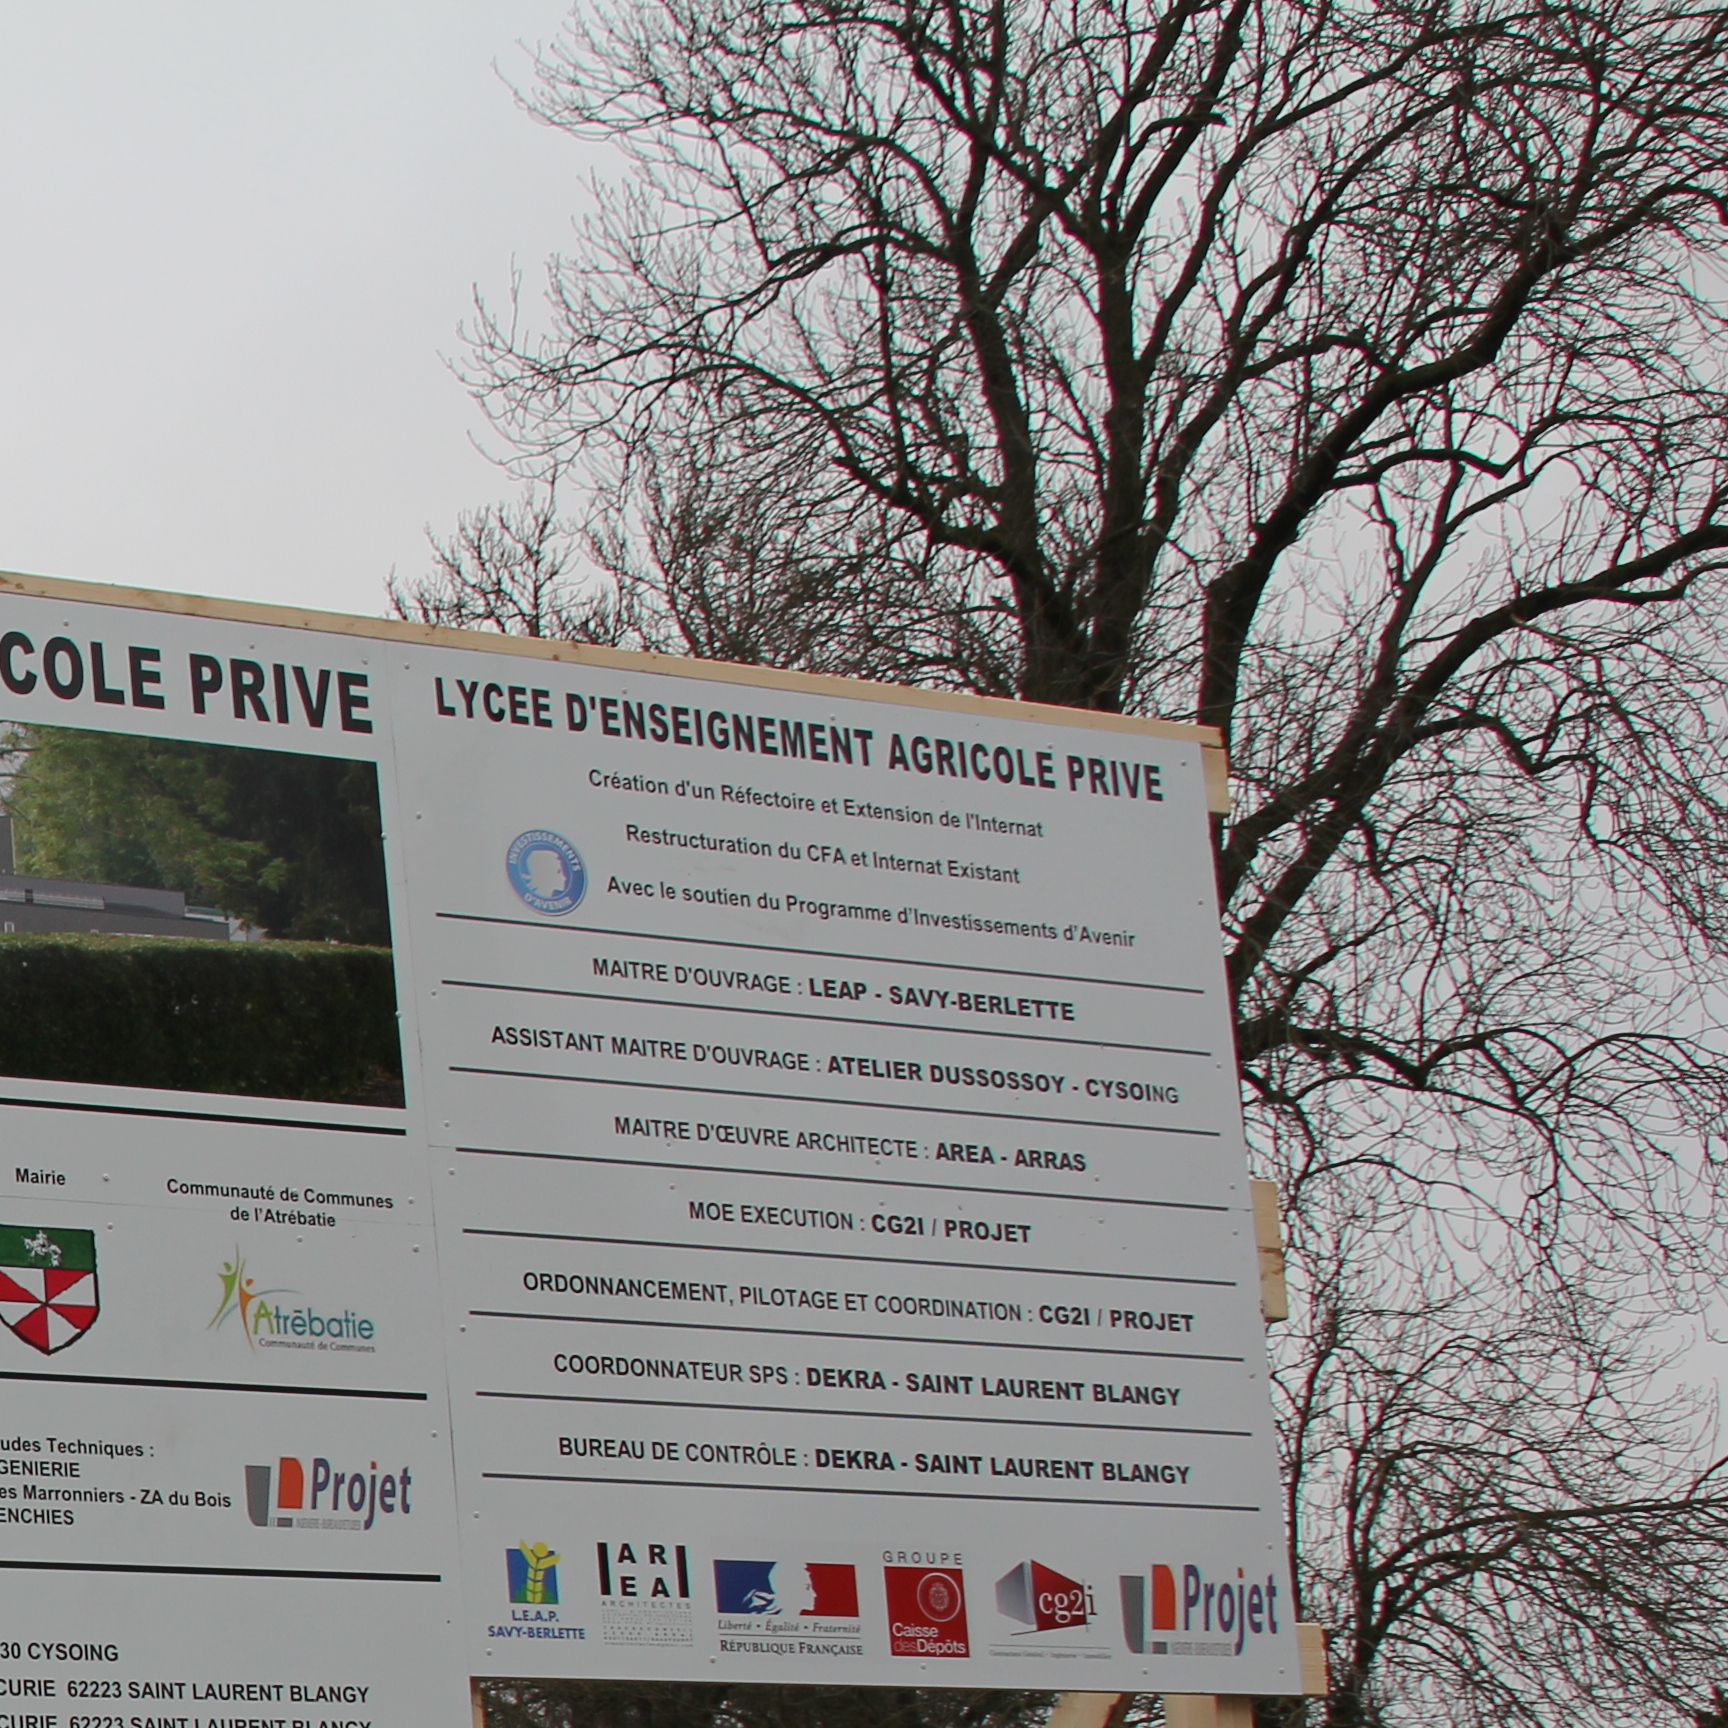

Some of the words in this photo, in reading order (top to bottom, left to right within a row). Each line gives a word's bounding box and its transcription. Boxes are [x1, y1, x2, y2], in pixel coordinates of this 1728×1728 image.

[188, 652, 374, 735] PRIVE
[434, 676, 553, 729] LYCEE
[565, 692, 874, 767] D'ENSEIGNEMENT
[888, 733, 1057, 789] AGRICOLE
[1066, 755, 1164, 802] PRIVE
[588, 768, 669, 795] Création
[674, 779, 715, 800] d'un
[720, 784, 815, 812] Réfectoire
[821, 798, 839, 815] et
[843, 798, 934, 825] Extension
[939, 810, 961, 829] de
[965, 812, 1043, 838] l'Internat
[508, 831, 582, 872] INVESTISSEMENTS
[626, 823, 772, 857] Restructuration
[777, 841, 801, 860] du
[806, 844, 847, 865] CFA
[850, 851, 869, 868] et
[872, 851, 943, 876] Internat
[947, 859, 1021, 884] Existant
[607, 875, 655, 898] Avec
[659, 881, 676, 900] le
[681, 887, 751, 908] soutien
[756, 892, 780, 911] du
[785, 894, 892, 923] Programme
[897, 907, 1058, 940] d'Investissements
[1063, 924, 1136, 947] d'Avenir
[15, 1167, 66, 1186] Mairie
[166, 1178, 275, 1201] Communauté
[279, 1187, 299, 1203] de
[303, 1188, 394, 1209] Communes
[230, 1206, 250, 1222] de
[254, 1207, 336, 1228] l'Atrébatie
[258, 1337, 315, 1350] Communauté
[317, 1341, 328, 1351] de
[329, 1341, 376, 1353] Communes
[310, 1457, 412, 1531] Projet
[882, 1550, 963, 1566] GROUPE
[511, 1609, 560, 1623] L.E.A.P.
[1037, 1585, 1099, 1624] cg2i
[1181, 1564, 1279, 1657] Projet
[487, 1625, 586, 1640] SAVY-BERLETTE
[891, 1622, 939, 1638] Caisse
[719, 1639, 796, 1656] RÉPUBLIQUE
[798, 1641, 864, 1657] FRANÇAISE
